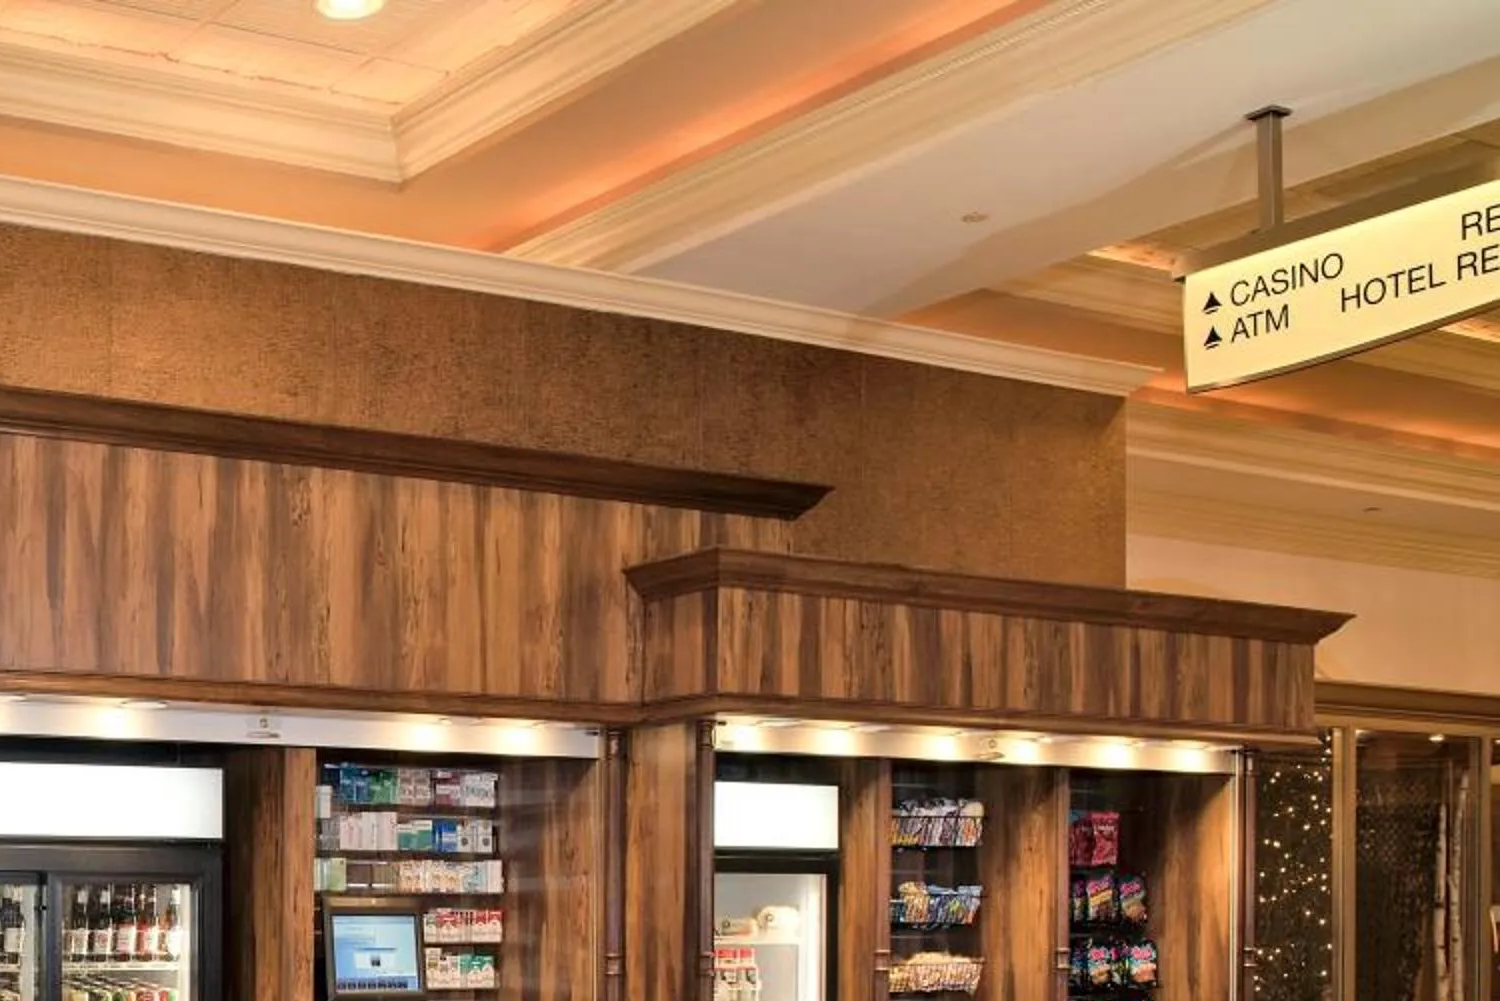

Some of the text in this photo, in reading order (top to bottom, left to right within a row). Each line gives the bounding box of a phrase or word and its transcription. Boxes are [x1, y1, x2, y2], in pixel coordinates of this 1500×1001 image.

[1229, 253, 1344, 307] CASINO
[1341, 263, 1446, 313] HOTEL
[1230, 304, 1290, 342] ATM
